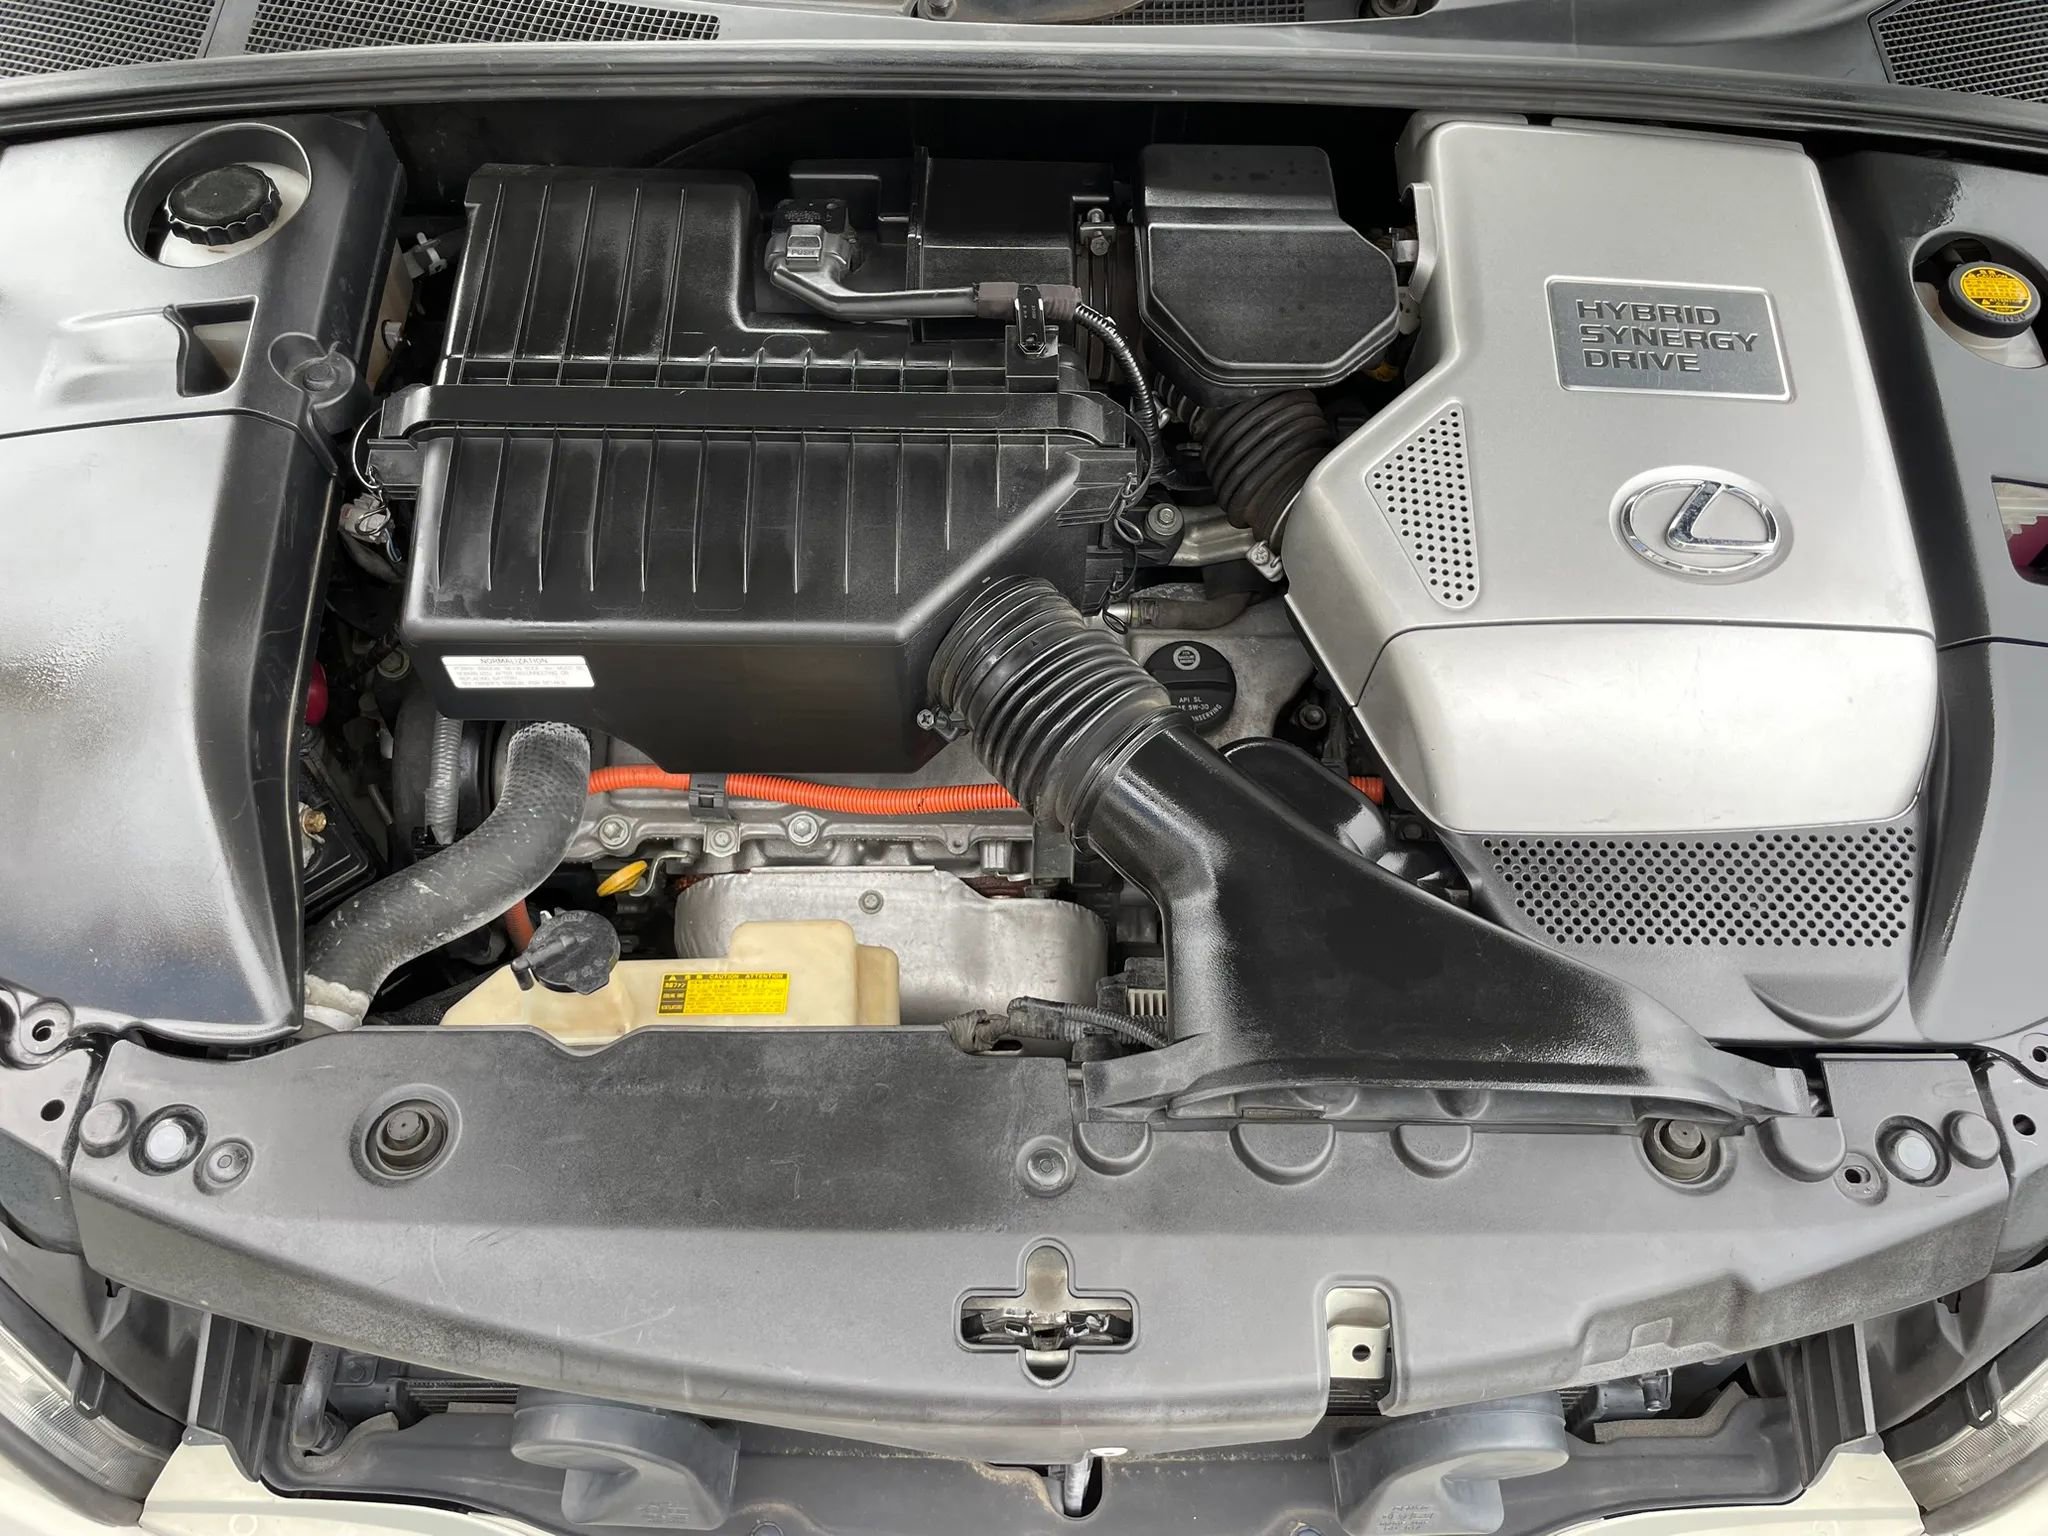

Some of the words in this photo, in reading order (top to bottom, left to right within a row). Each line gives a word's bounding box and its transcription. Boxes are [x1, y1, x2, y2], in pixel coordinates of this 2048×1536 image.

[1575, 298, 1721, 326] HYBRID
[1579, 322, 1759, 353] SYNERGY
[1581, 348, 1702, 373] DRIVE
[480, 657, 549, 665] NORMALIZATION
